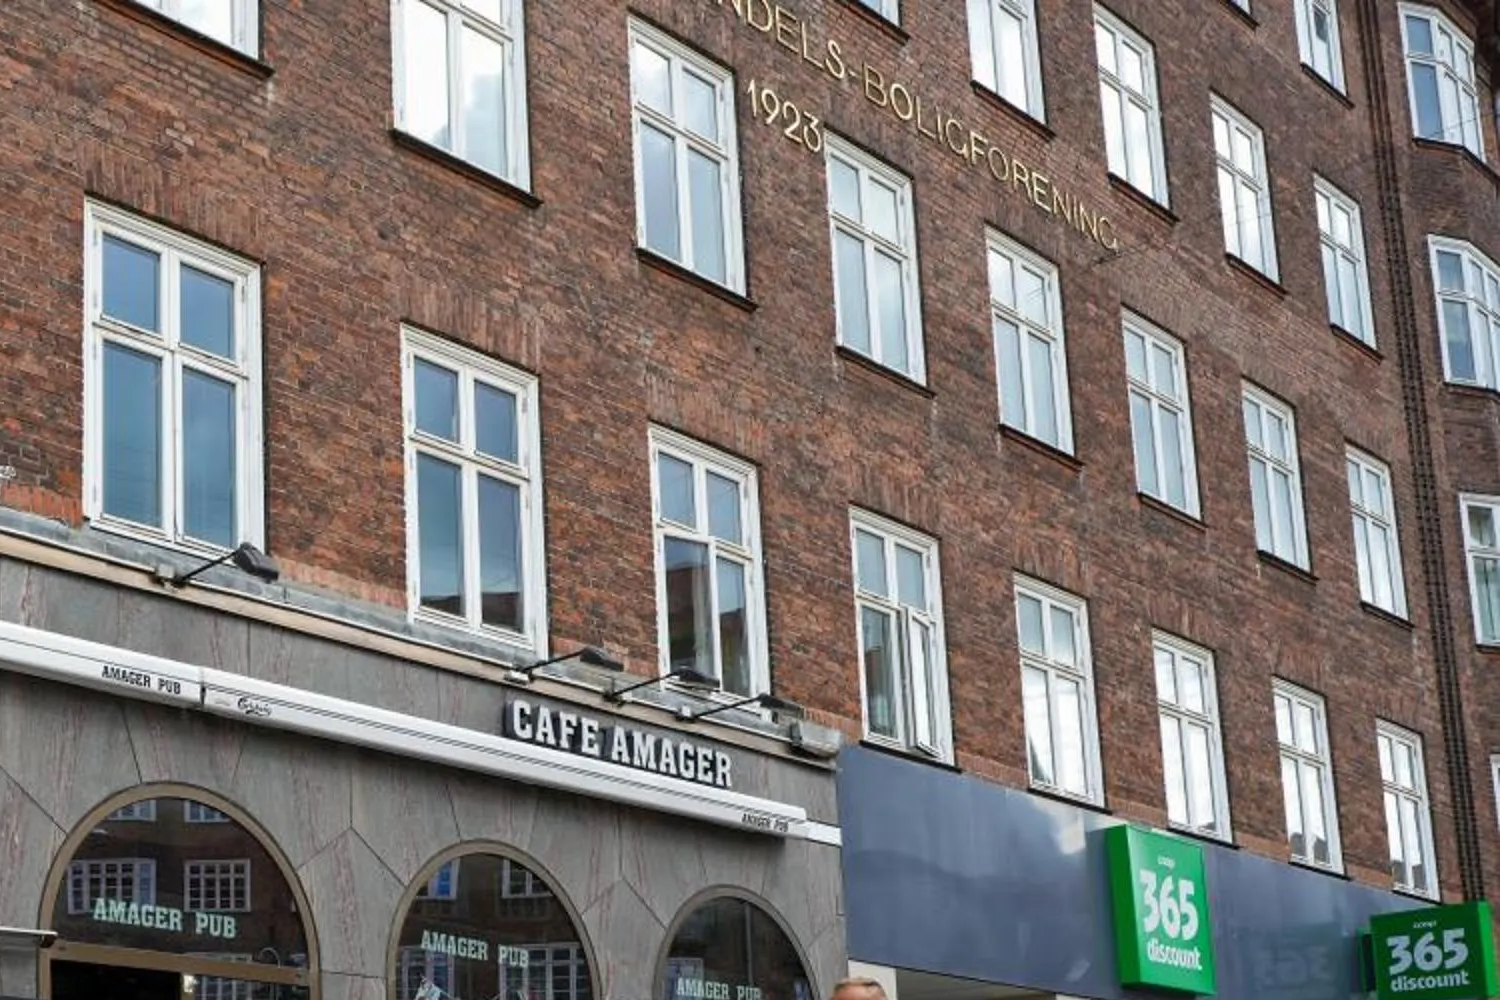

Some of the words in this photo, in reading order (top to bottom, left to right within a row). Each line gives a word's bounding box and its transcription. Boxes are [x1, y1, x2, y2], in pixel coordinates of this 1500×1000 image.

[746, 79, 822, 153] 1923
[101, 665, 151, 688] AMAGER
[158, 677, 181, 696] PUB
[508, 699, 602, 757] CAFE
[611, 725, 734, 788] AMAGER
[93, 898, 184, 933] AMAGER
[195, 911, 237, 939] PUB
[1139, 868, 1199, 941] 365
[420, 929, 489, 961] AMAGER
[497, 943, 529, 968] PUB
[1147, 938, 1203, 971] discount
[1386, 927, 1469, 976] 365
[677, 977, 731, 1000] AMAGER
[1390, 971, 1470, 993] discount
